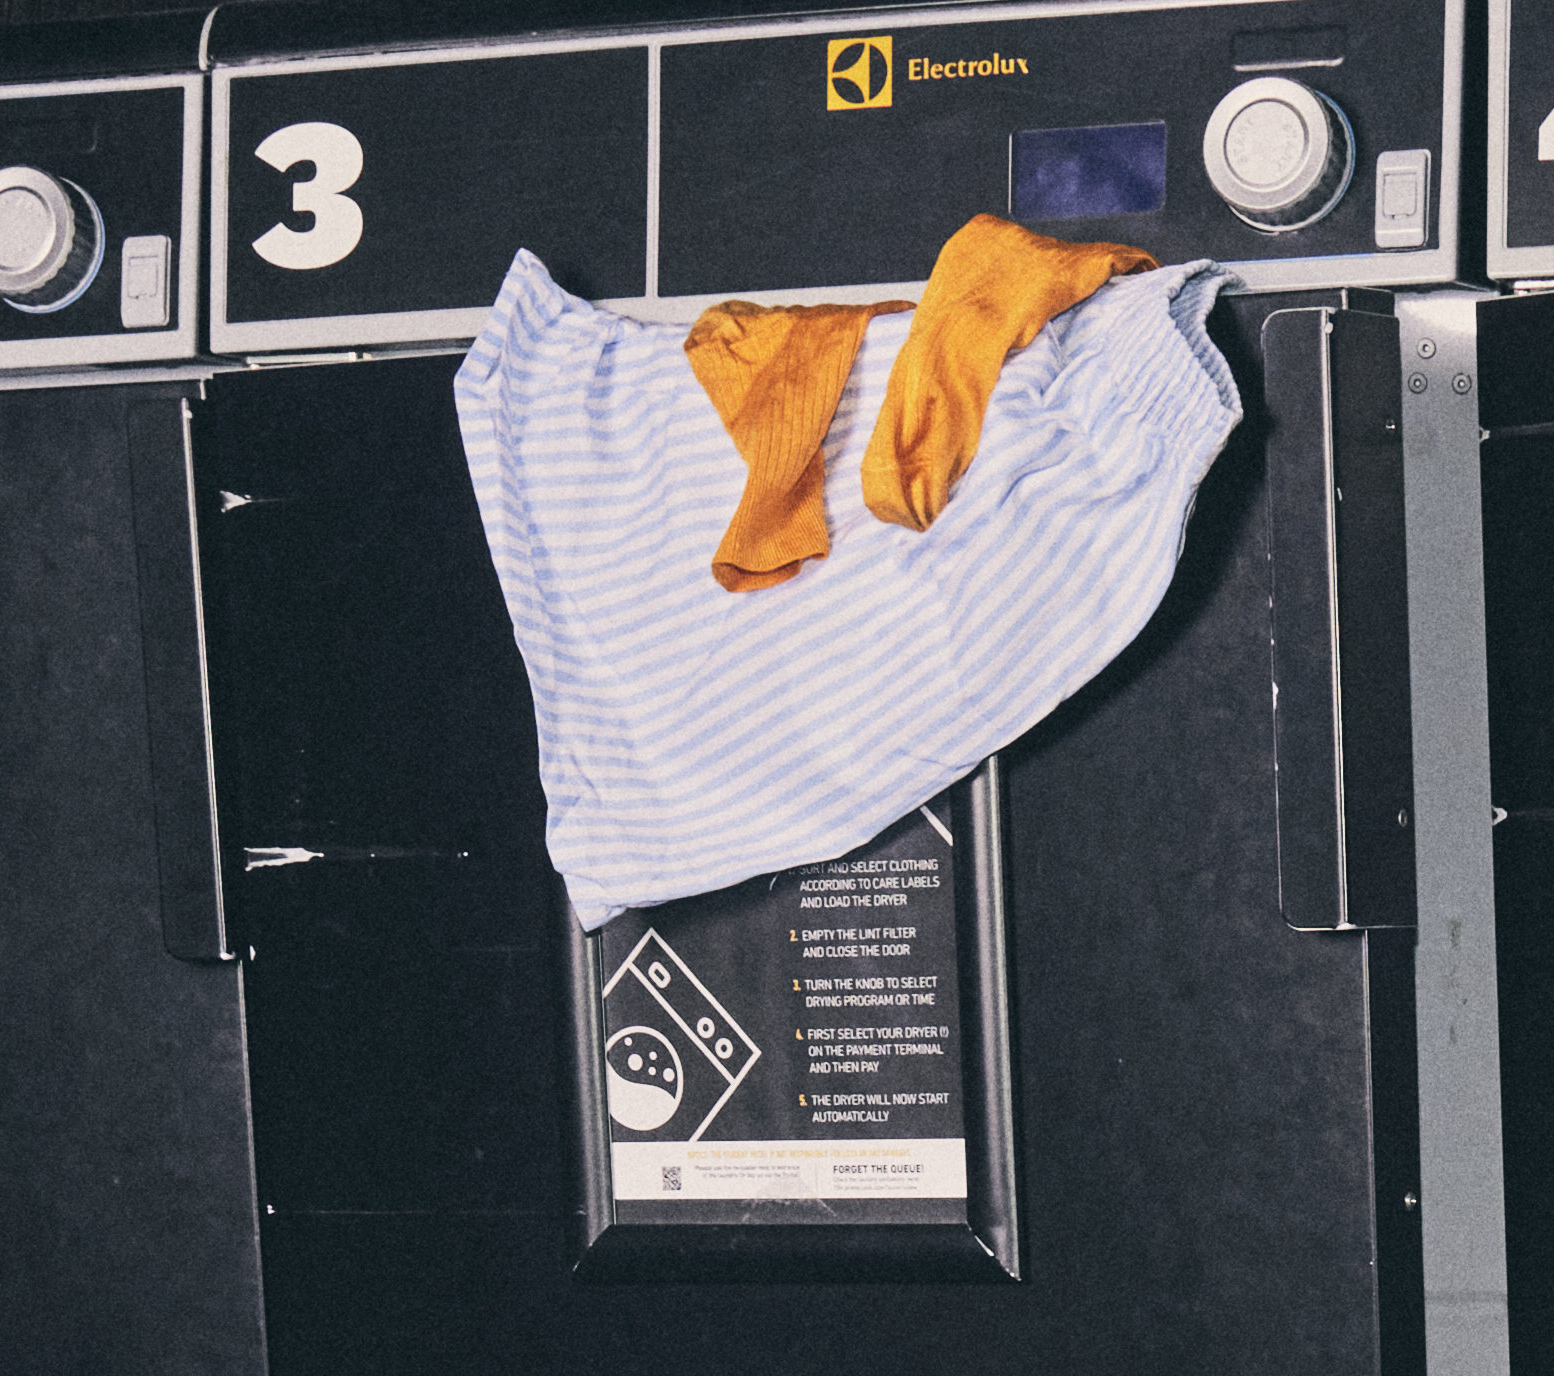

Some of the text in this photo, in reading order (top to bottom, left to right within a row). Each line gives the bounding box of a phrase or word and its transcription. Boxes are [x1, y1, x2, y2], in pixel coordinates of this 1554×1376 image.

[909, 52, 1029, 81] Electrolux
[252, 122, 363, 269] 3
[802, 929, 835, 941] EMPTY
[836, 928, 857, 940] THE
[859, 928, 881, 940] LINT
[883, 927, 917, 939] FILTER
[803, 944, 911, 958] AND CLOSE THE DOOR
[833, 1164, 868, 1174] FORGET
[870, 1164, 889, 1173] THE
